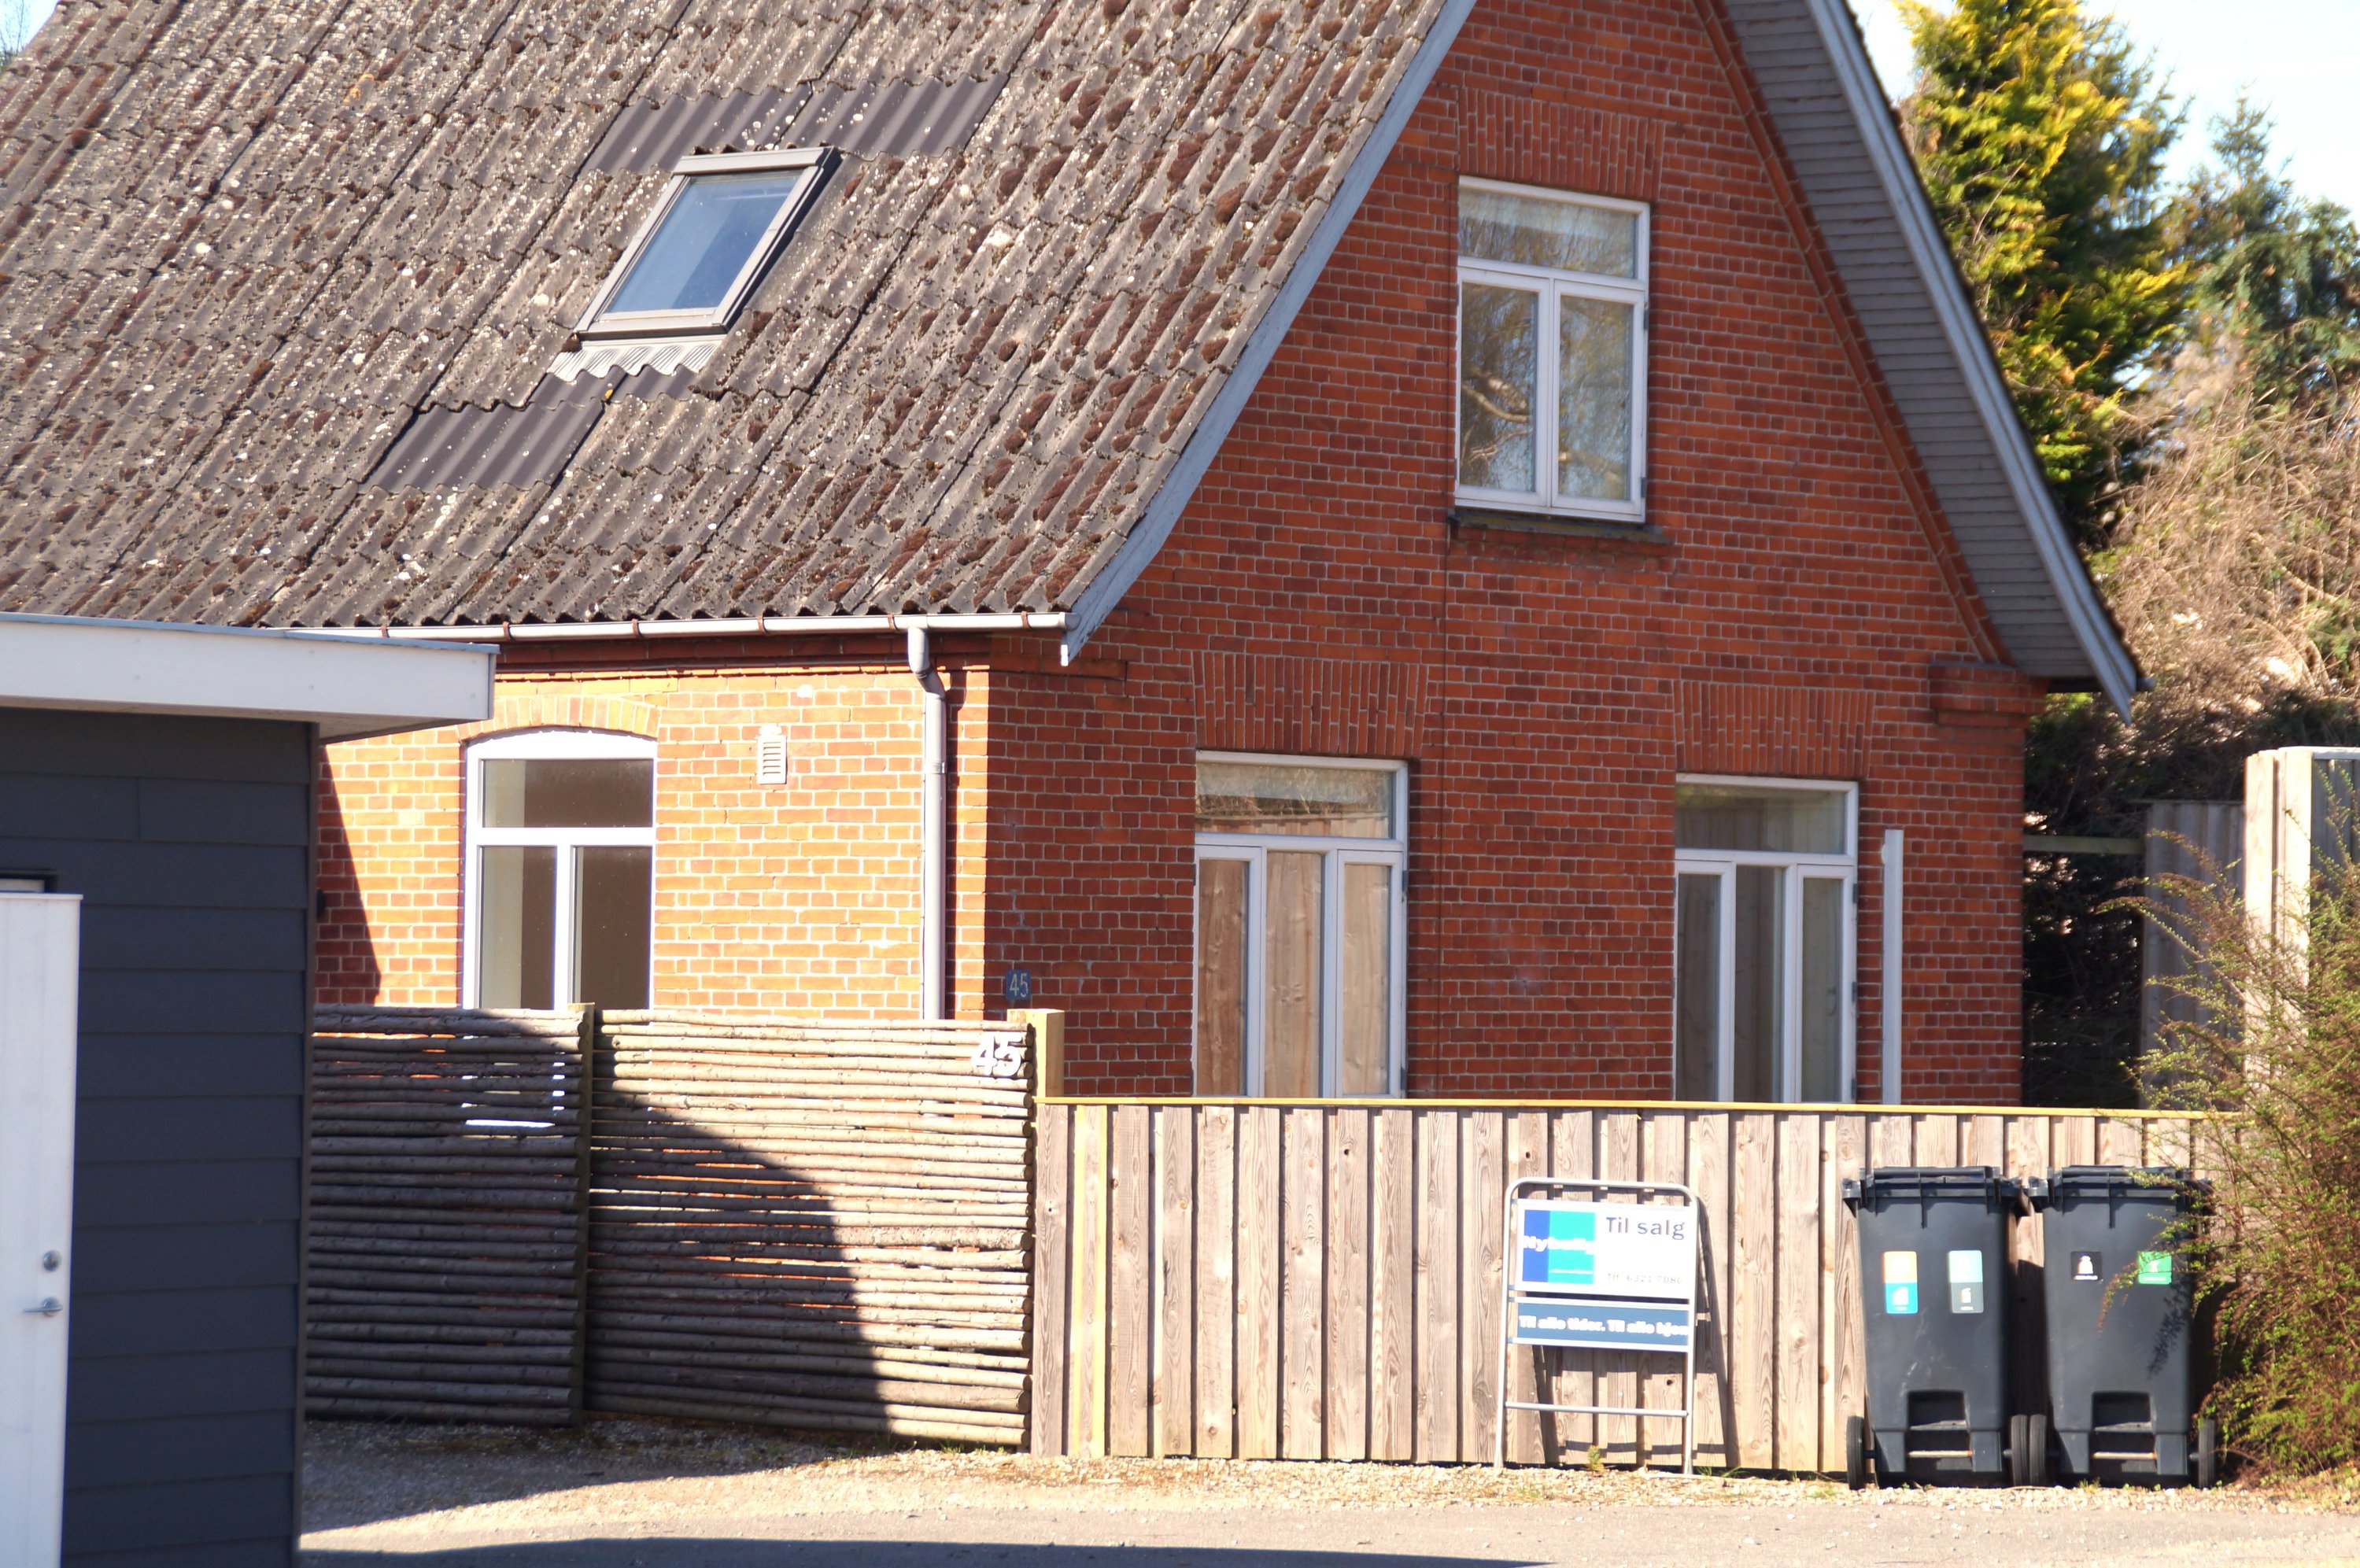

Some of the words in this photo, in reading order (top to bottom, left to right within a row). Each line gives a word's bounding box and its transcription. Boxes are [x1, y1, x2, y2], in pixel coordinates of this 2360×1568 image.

[1008, 972, 1029, 998] 45
[970, 1031, 1023, 1077] 45
[1605, 1216, 1630, 1234] Til
[1637, 1219, 1686, 1241] salg
